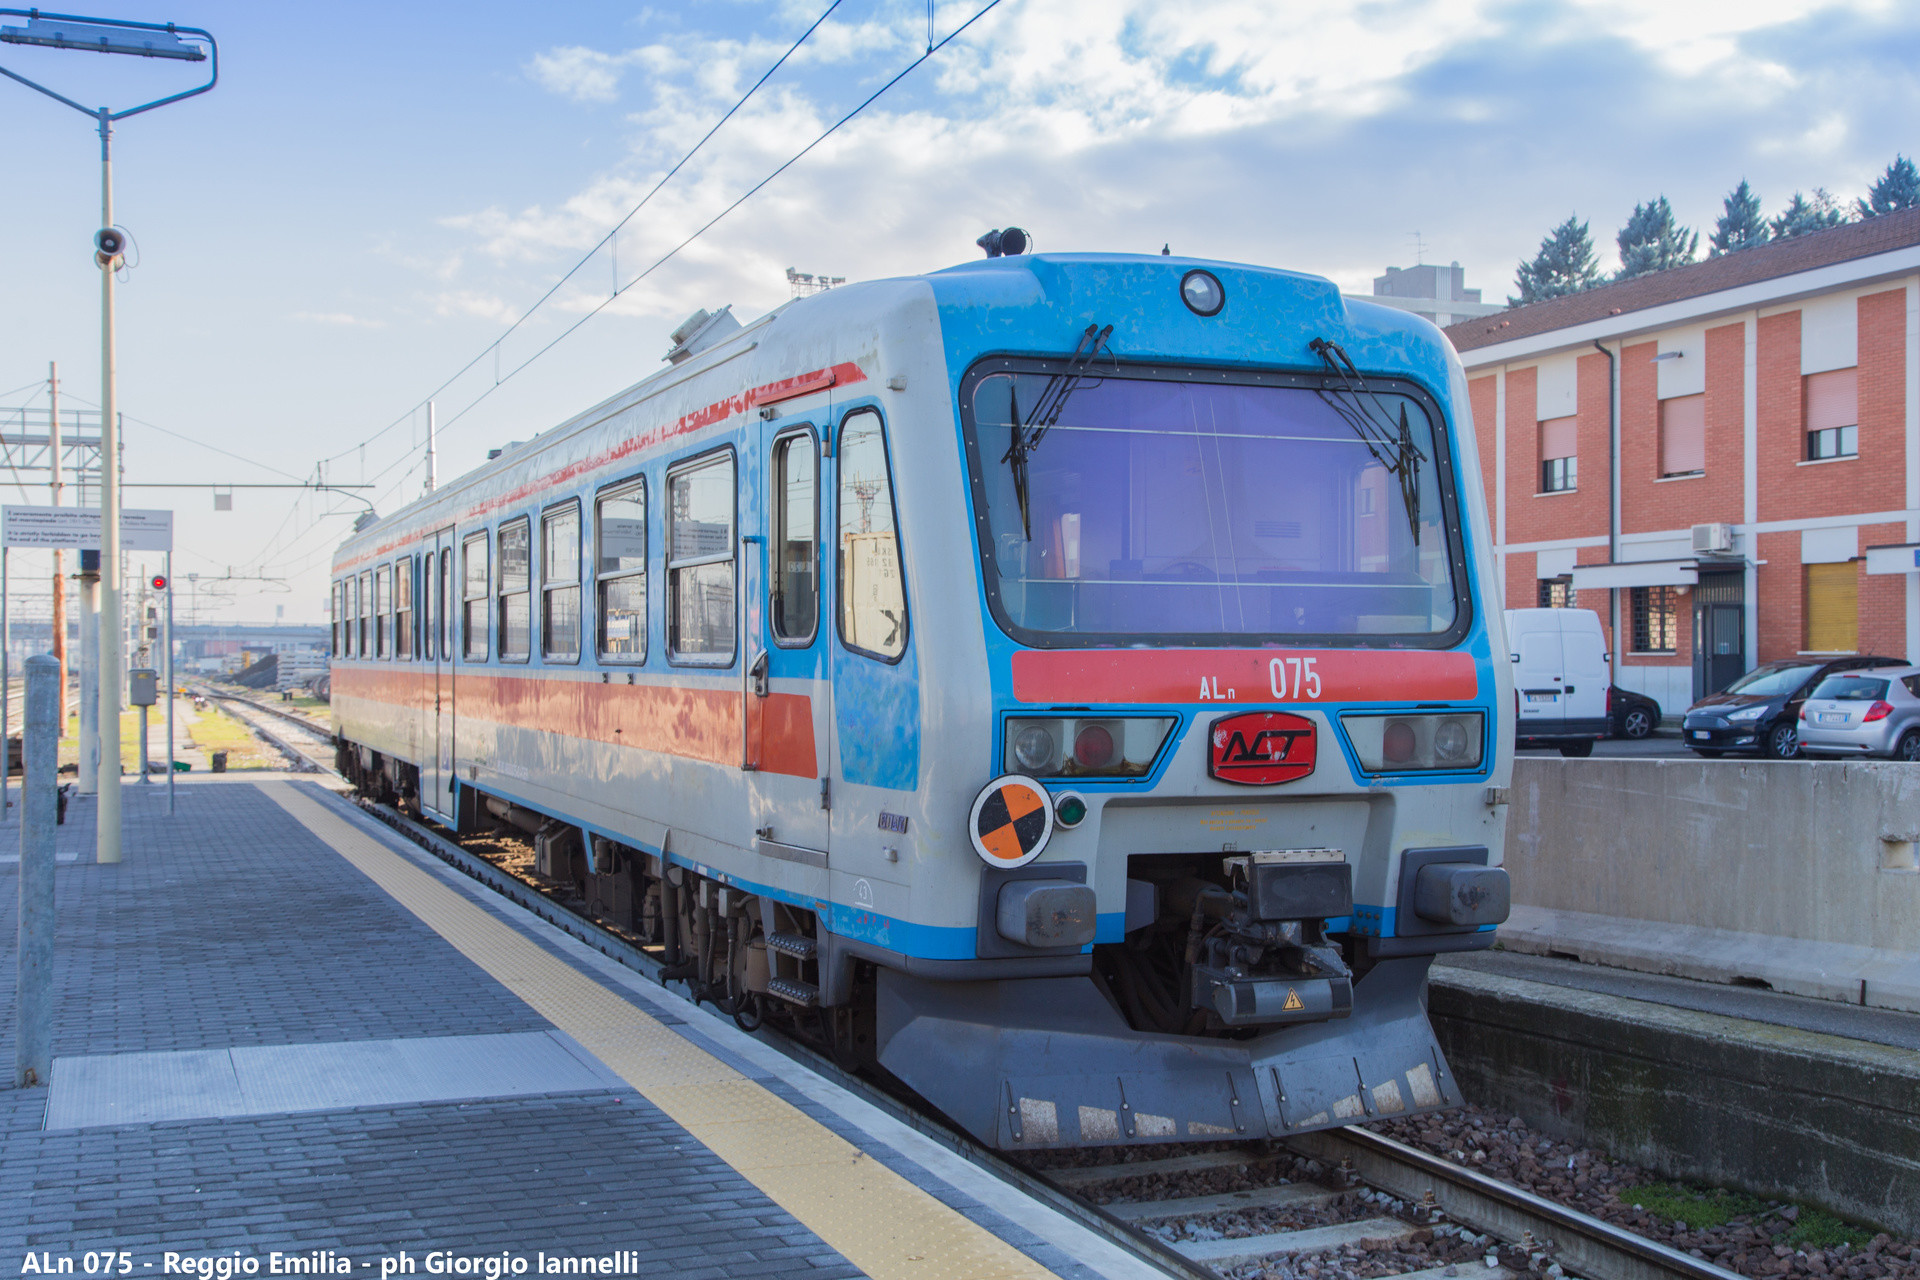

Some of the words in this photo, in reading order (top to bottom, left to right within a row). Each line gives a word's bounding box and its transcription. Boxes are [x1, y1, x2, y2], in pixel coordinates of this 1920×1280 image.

[1199, 676, 1236, 699] ALn
[1269, 657, 1322, 699] 075
[1220, 729, 1312, 762] ACT
